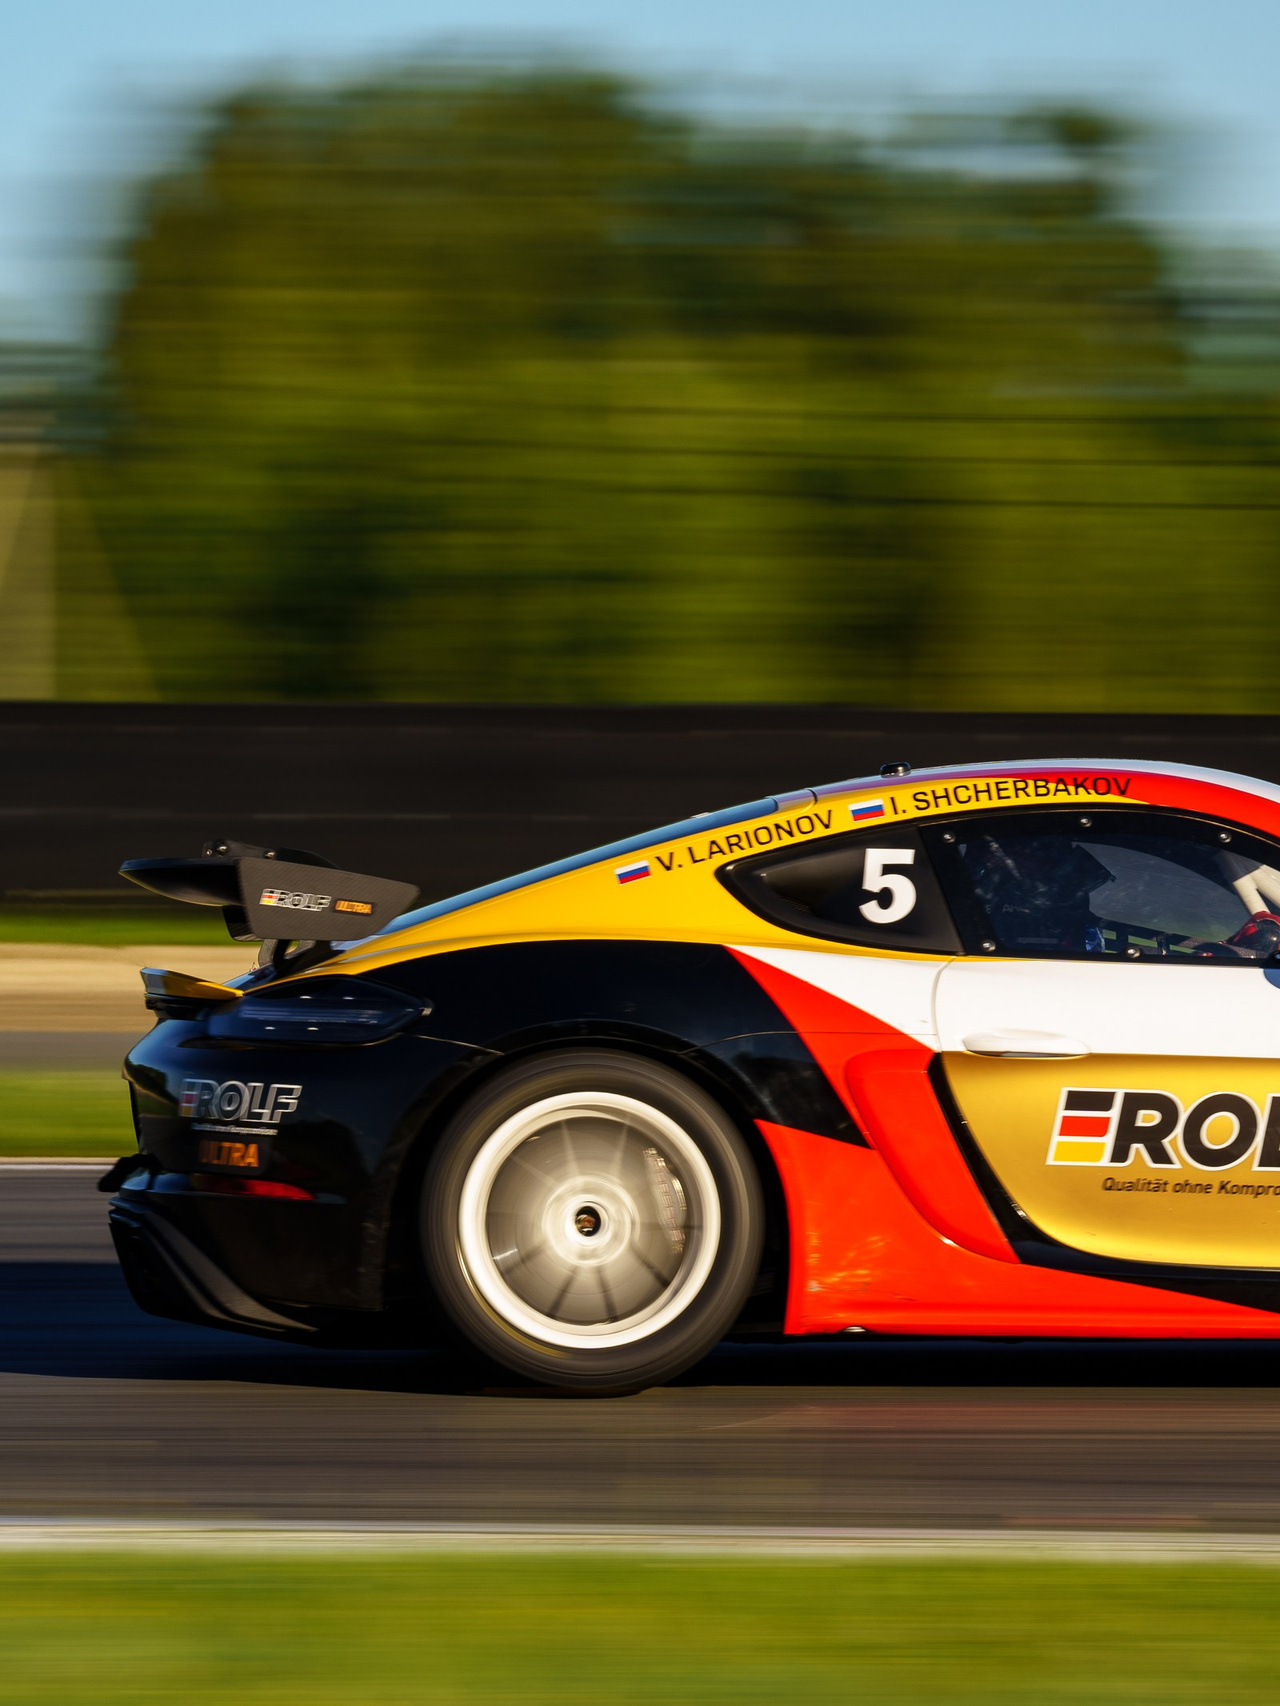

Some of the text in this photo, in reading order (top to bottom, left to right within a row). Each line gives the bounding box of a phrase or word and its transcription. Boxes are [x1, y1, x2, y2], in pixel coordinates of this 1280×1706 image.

[889, 777, 1131, 815] I. SHCHERBAKOV
[655, 809, 833, 871] V. LARIONOV
[859, 848, 917, 924] 5
[198, 1079, 303, 1124] ROLF
[1102, 1177, 1169, 1193] Qualität
[1173, 1179, 1214, 1195] ohne
